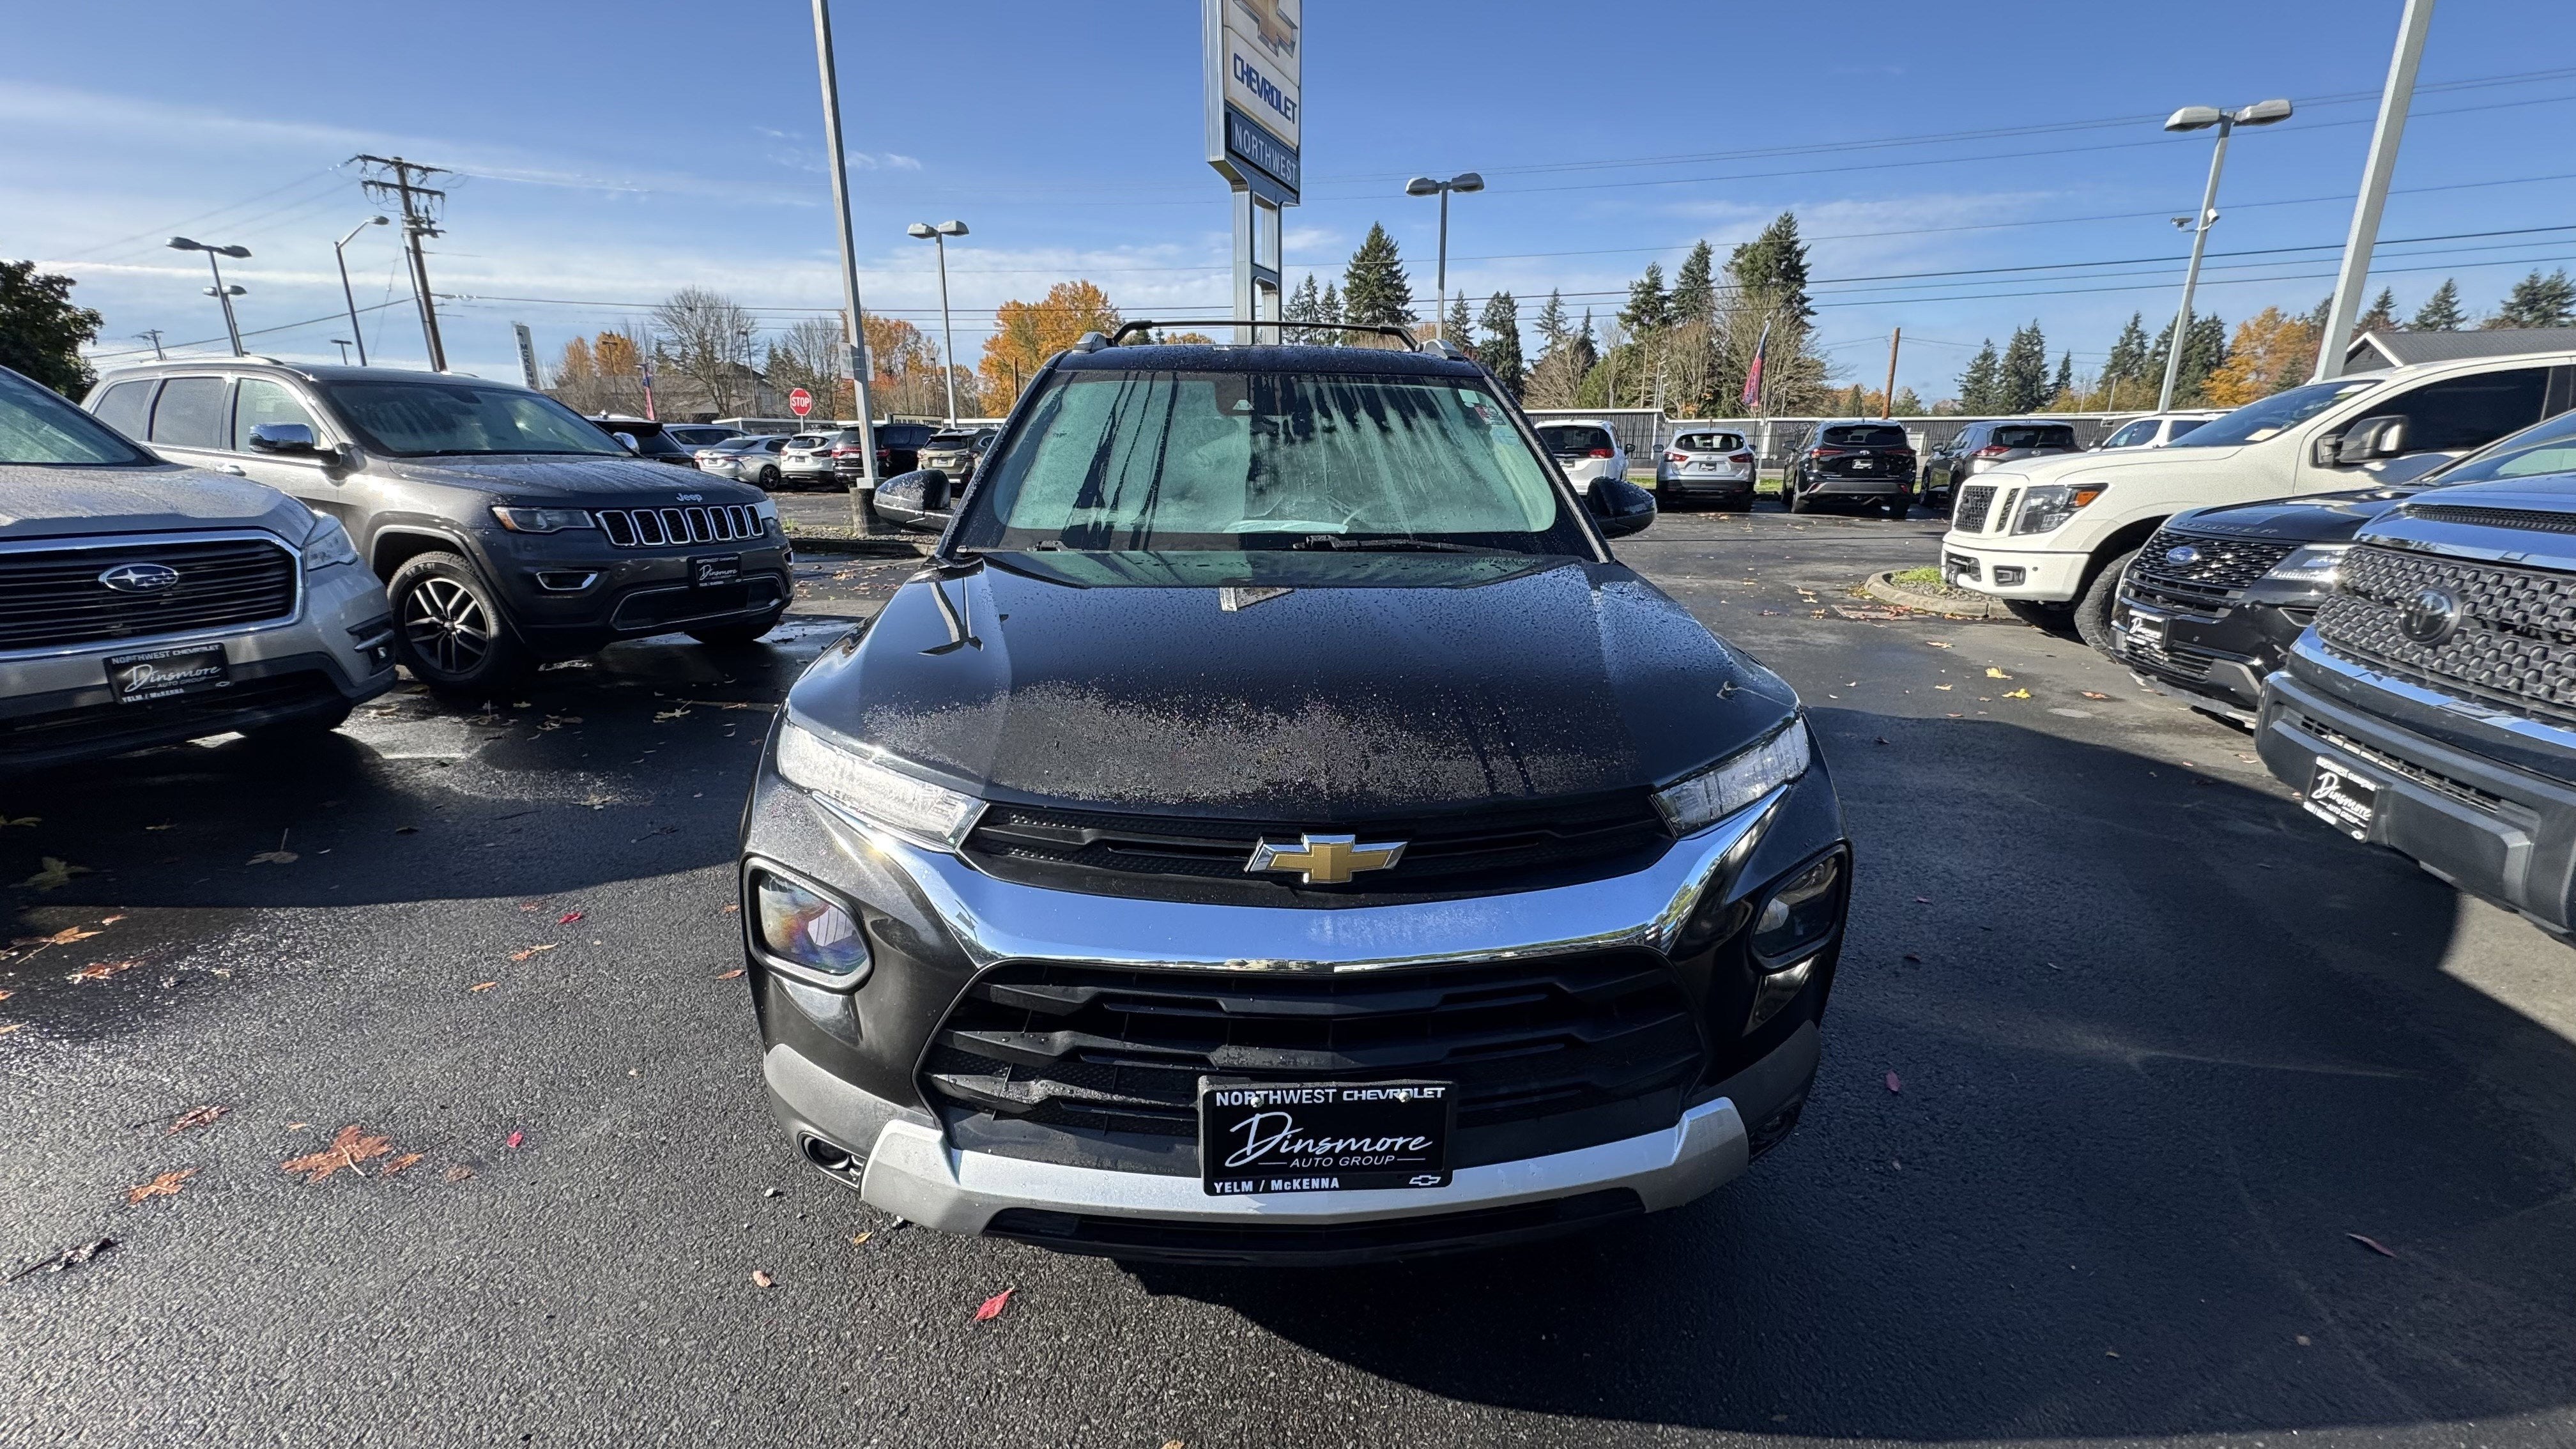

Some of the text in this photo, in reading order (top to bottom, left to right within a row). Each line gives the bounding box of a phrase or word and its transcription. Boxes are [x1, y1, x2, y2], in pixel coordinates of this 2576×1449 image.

[1234, 52, 1297, 124] CHEVROLET
[1234, 123, 1297, 184] NORTHWEST
[792, 397, 809, 407] STOP
[676, 493, 702, 502] Jeep
[111, 650, 171, 664] NORTHWEST
[122, 664, 222, 693] Dinsmore
[1216, 1087, 1445, 1106] NORTHWEST CHEVROLET
[1224, 1112, 1432, 1167] Dinsmore
[1290, 1155, 1395, 1168] AUTO GROUP
[1214, 1180, 1253, 1193] YELM
[1271, 1177, 1339, 1190] McKENNA
